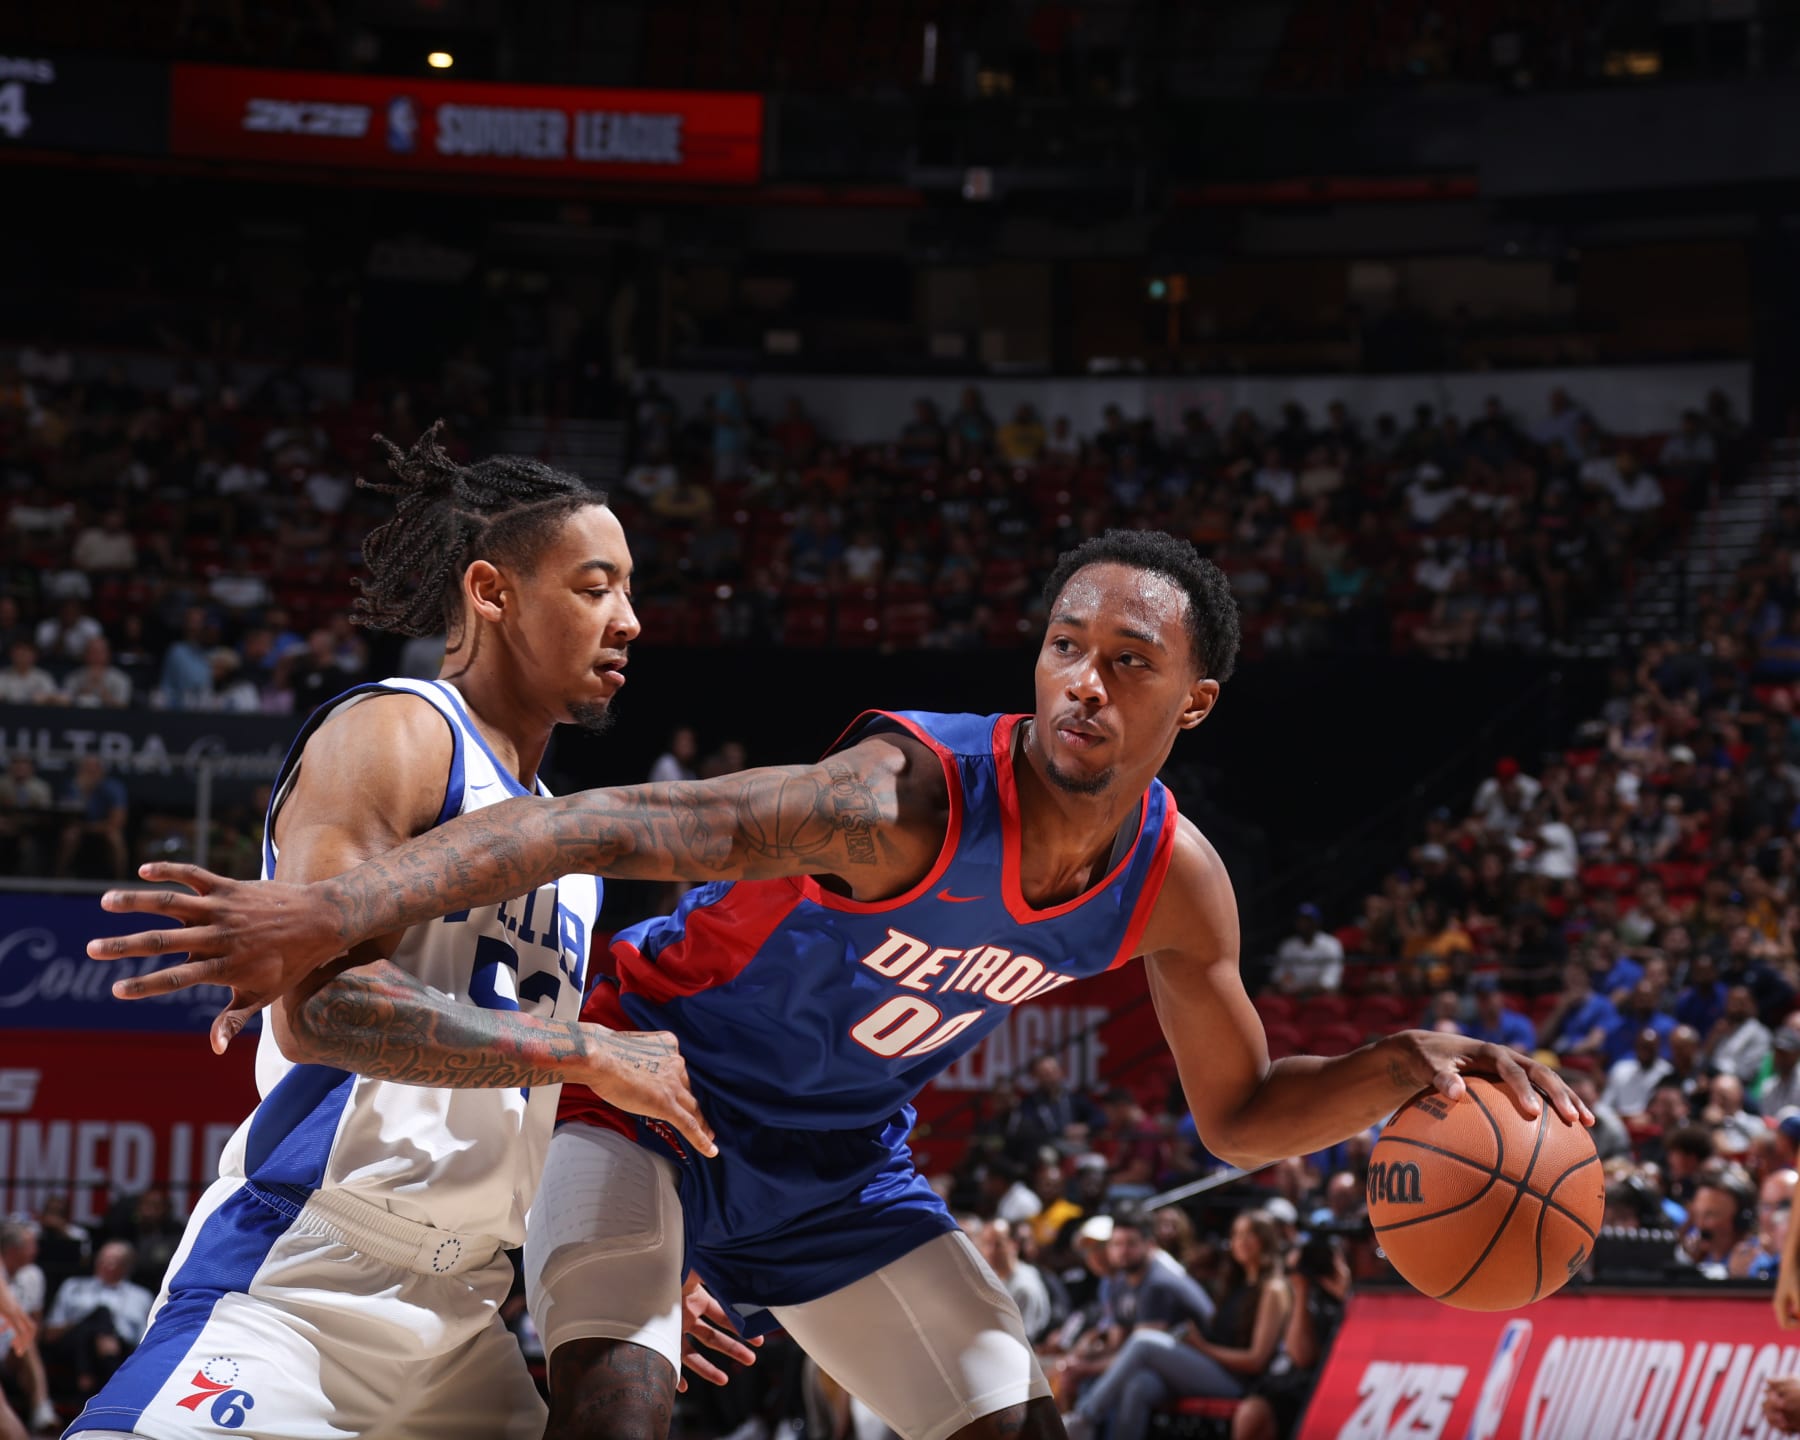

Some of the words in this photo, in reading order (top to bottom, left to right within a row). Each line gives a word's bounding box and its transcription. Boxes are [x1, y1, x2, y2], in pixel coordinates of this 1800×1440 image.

[434, 102, 569, 161] SUMMER
[573, 107, 685, 165] LEAGUE
[176, 1369, 255, 1429] 76
